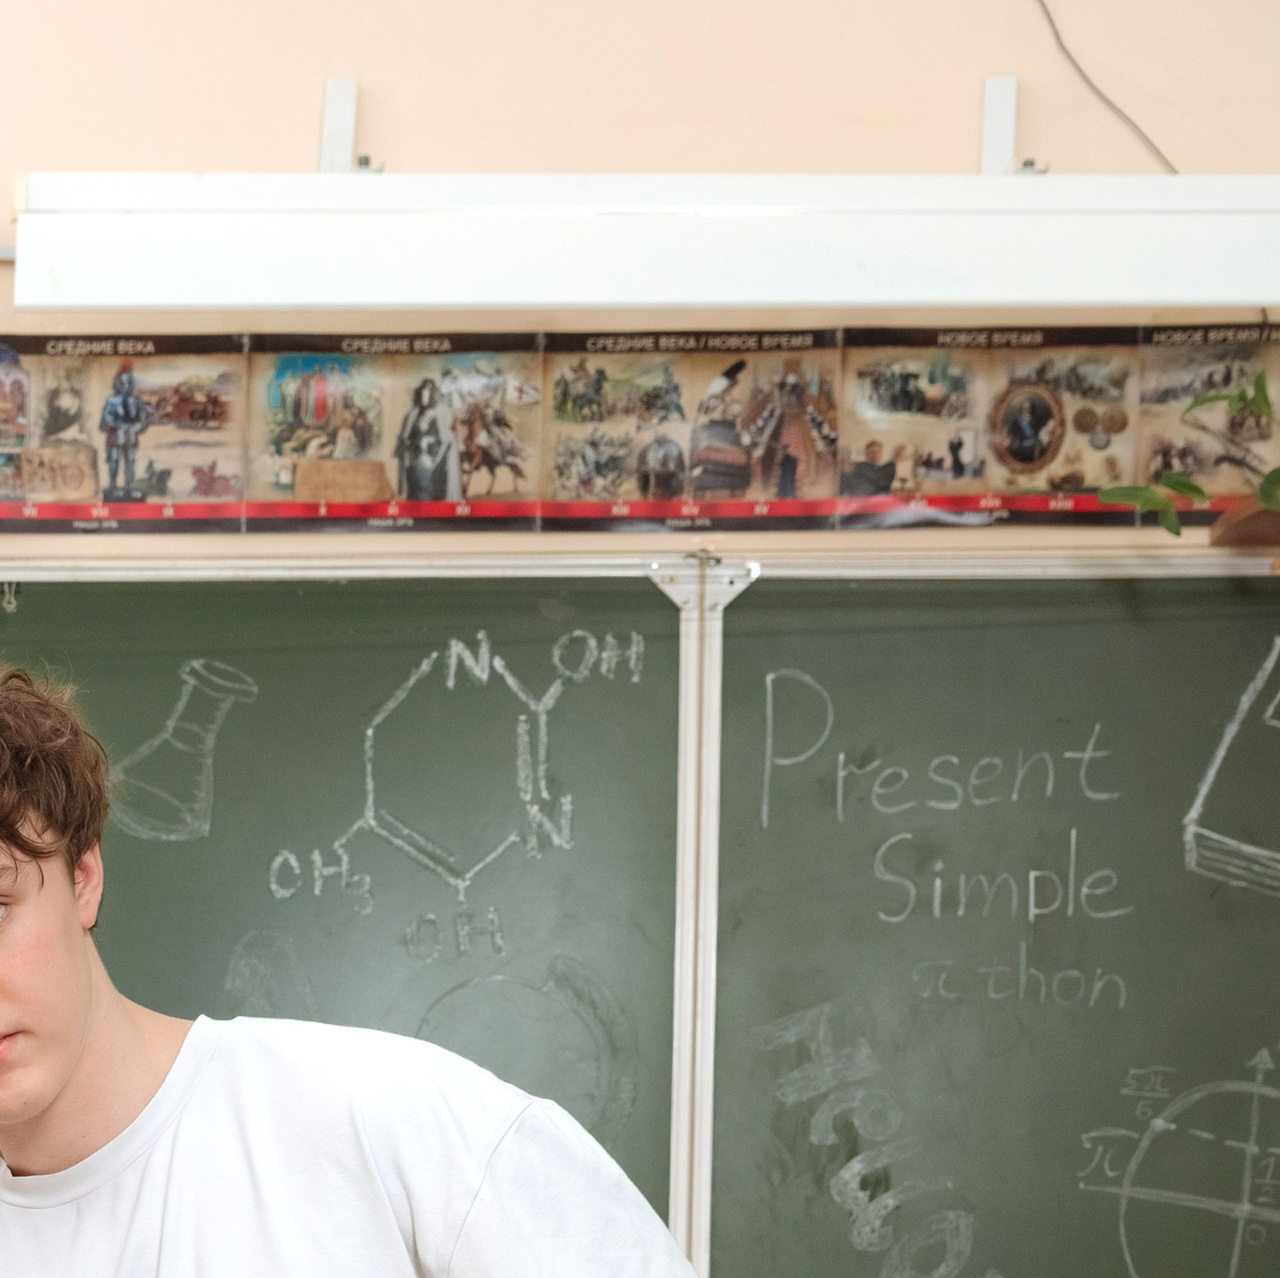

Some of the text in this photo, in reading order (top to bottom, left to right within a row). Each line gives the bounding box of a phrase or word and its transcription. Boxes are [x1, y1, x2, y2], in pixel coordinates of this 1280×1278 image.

[46, 340, 155, 356] СРЕДНИЕ ВЕКА
[342, 337, 452, 353] СРЕДНИЕ ВЕКА
[586, 336, 656, 351] СРЕДНИЕ
[658, 336, 697, 350] ВЕКА
[707, 335, 759, 349] НОВОЕ
[761, 333, 814, 349] ВРЕМЯ
[937, 331, 1044, 347] НОВОЕ ВРЕМЯ
[1153, 329, 1205, 346] НОВОЕ
[1207, 327, 1260, 343] ВРЕМЯ
[447, 630, 489, 689] N
[552, 630, 645, 683] OH
[762, 668, 1122, 828] Present
[527, 794, 574, 859] N
[873, 828, 1132, 923] Simple
